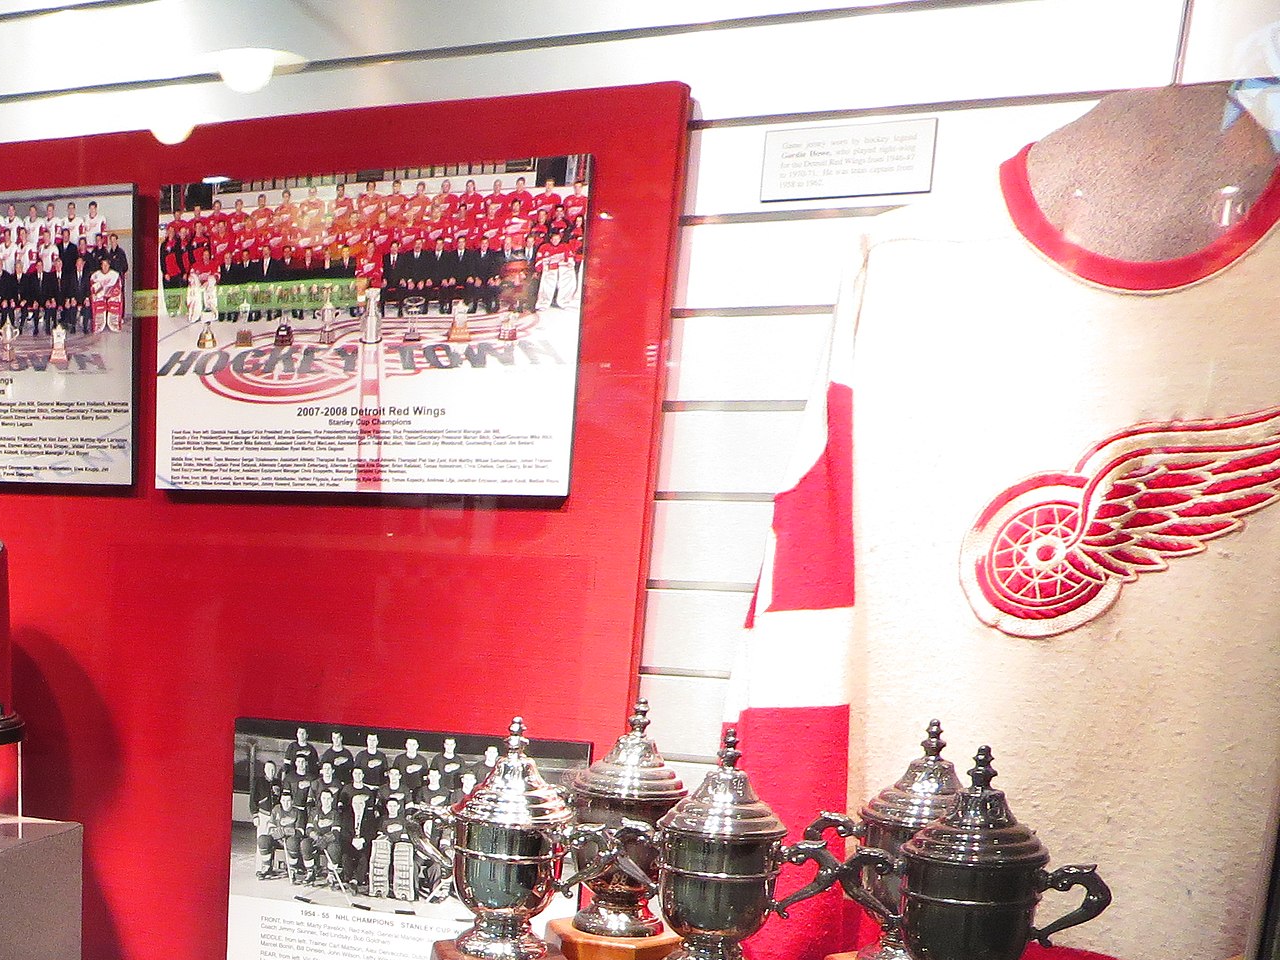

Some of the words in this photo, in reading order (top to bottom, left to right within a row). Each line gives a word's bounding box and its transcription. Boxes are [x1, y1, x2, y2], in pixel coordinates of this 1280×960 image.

[297, 406, 347, 416] 2007-2008
[350, 406, 385, 417] Detroit
[388, 406, 410, 416] Red
[413, 406, 446, 417] Wings
[328, 418, 353, 427] Stanley
[355, 418, 370, 428] Cup
[372, 418, 412, 427] Champions
[352, 916, 394, 927] CHAMPIONS
[401, 922, 433, 932] STANLEY
